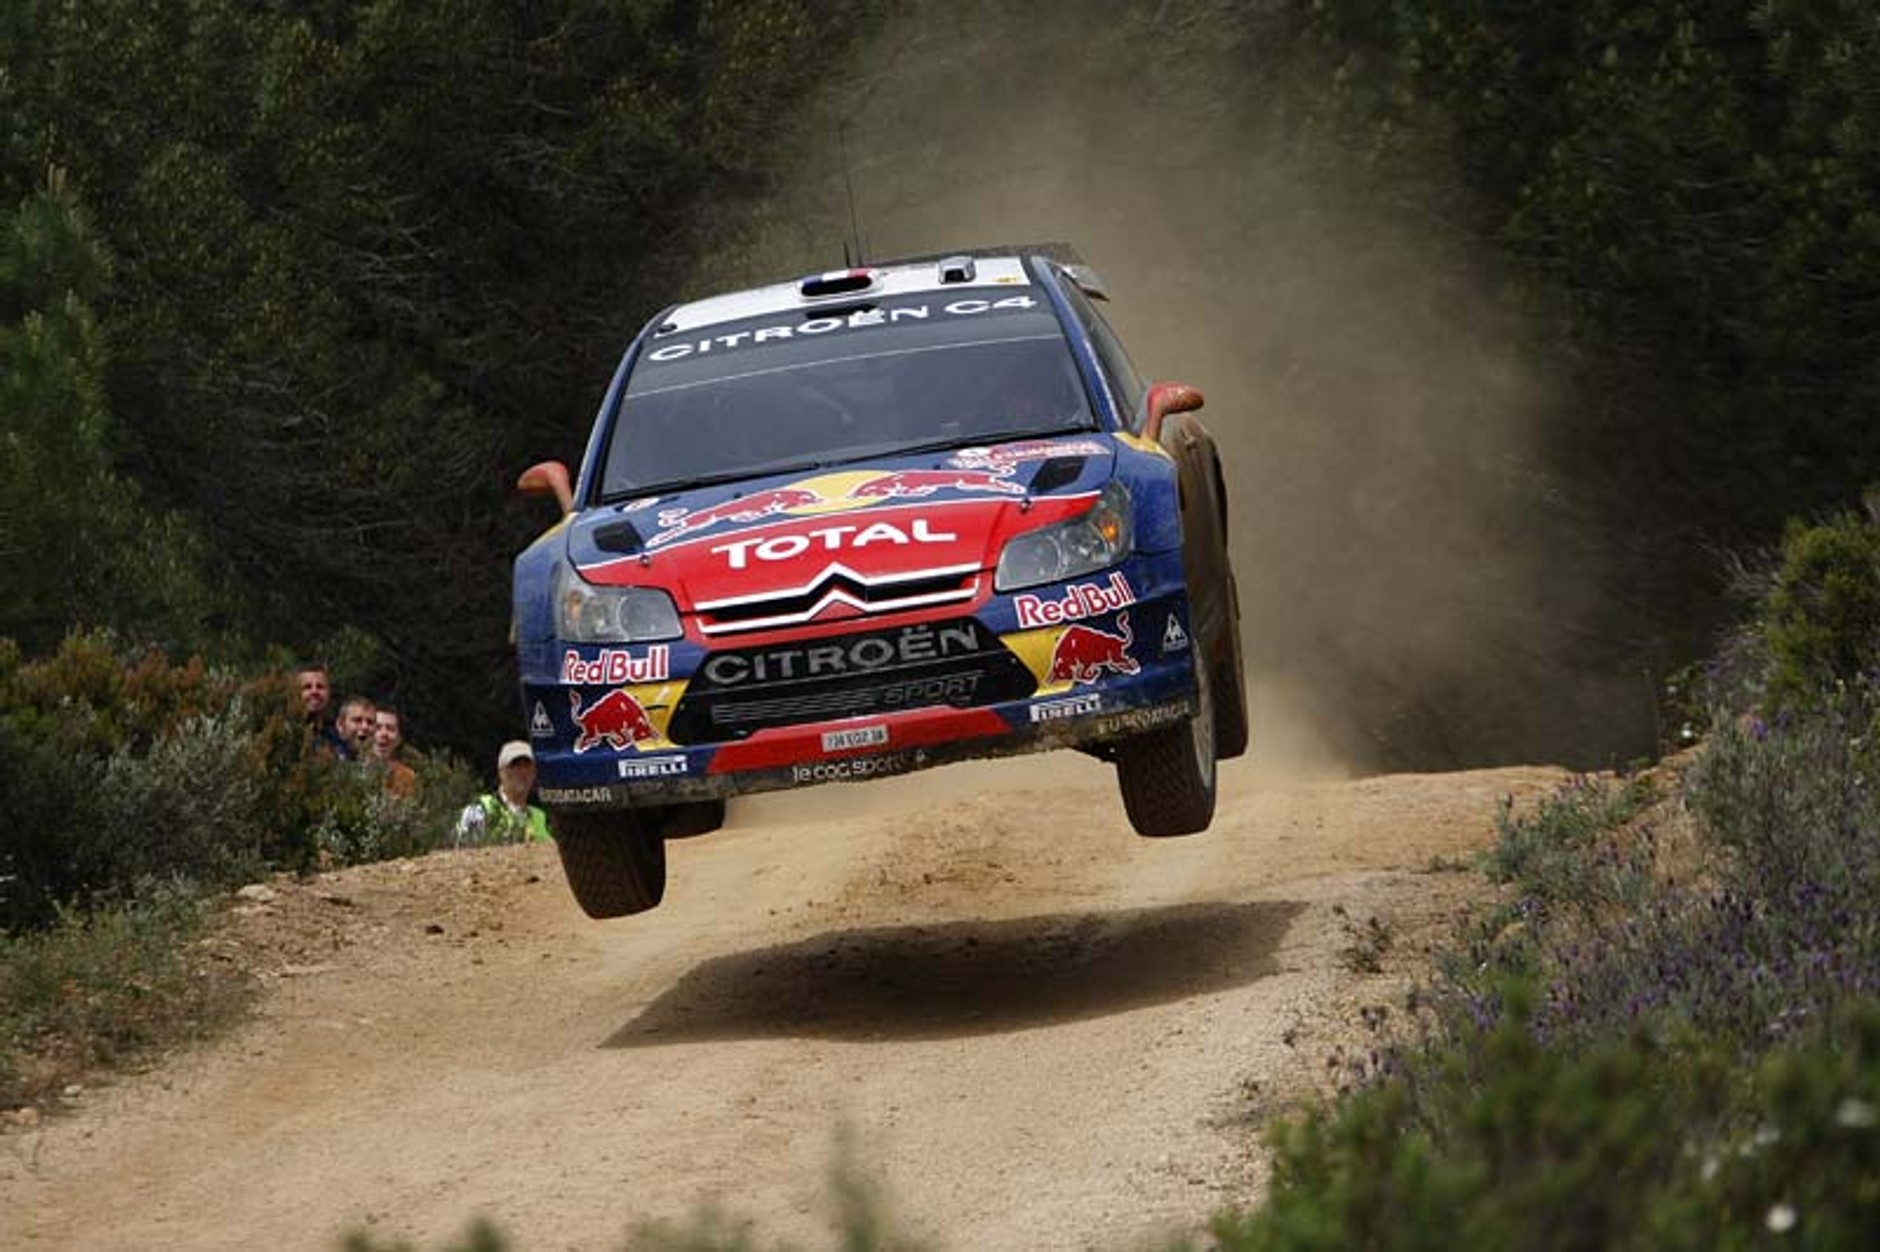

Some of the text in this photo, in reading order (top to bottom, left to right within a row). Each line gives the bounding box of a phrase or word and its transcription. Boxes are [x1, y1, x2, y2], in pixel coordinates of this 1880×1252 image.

[649, 296, 1037, 361] CITROËN C4
[711, 519, 957, 569] TOTAL
[1014, 571, 1136, 628] Red Bull
[560, 645, 669, 685] Red Bull
[704, 624, 979, 685] CITROËN
[884, 676, 979, 703] SPORT
[1029, 693, 1100, 723] PIRELLI
[618, 755, 688, 778] PIRELLI
[793, 765, 811, 783] le
